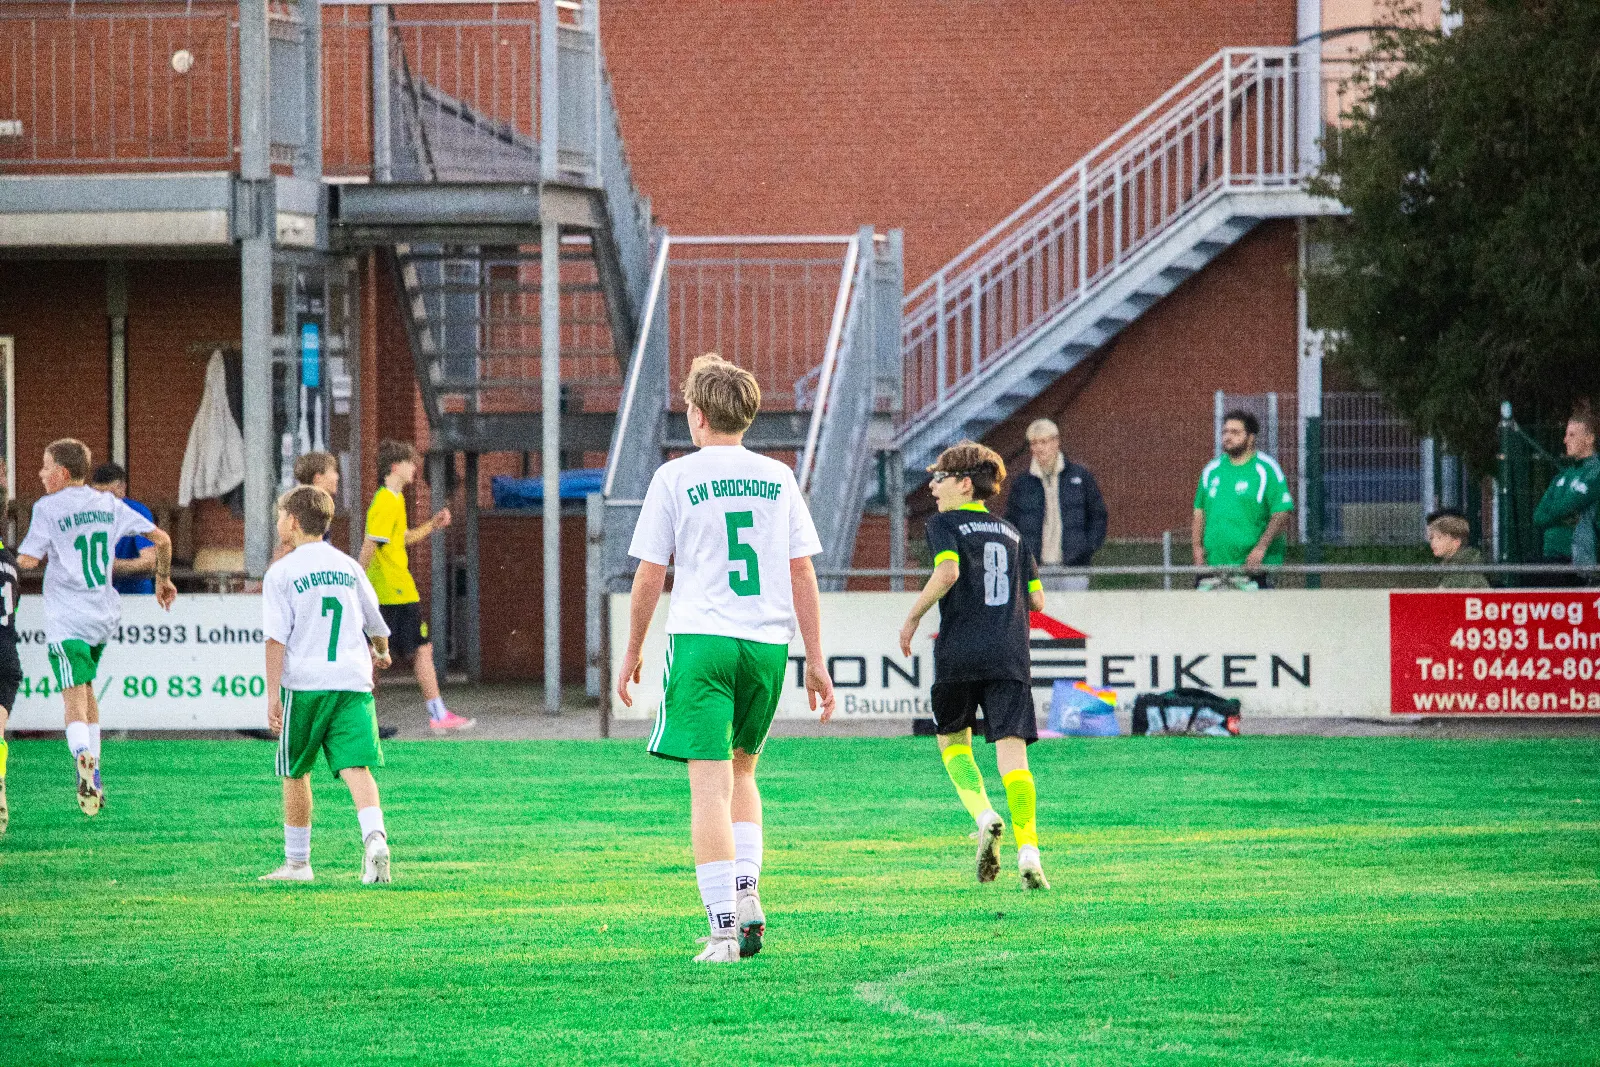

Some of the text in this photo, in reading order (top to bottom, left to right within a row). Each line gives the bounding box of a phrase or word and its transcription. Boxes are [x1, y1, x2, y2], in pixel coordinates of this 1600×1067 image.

[686, 479, 782, 506] GW BROCKDORF
[58, 515, 73, 532] GW
[74, 531, 110, 589] 10
[724, 510, 761, 597] 5
[293, 575, 311, 594] GW
[983, 541, 1010, 607] 8
[1464, 597, 1584, 626] Bergweg
[111, 625, 187, 644] 49393
[196, 625, 265, 644] Lohne
[321, 596, 344, 662] 7
[1450, 627, 1529, 651] 49393
[1101, 655, 1311, 688] EIKEN
[1415, 657, 1464, 681] Tel:
[123, 675, 158, 699] 80
[167, 675, 203, 699] 83
[211, 675, 266, 699] 460
